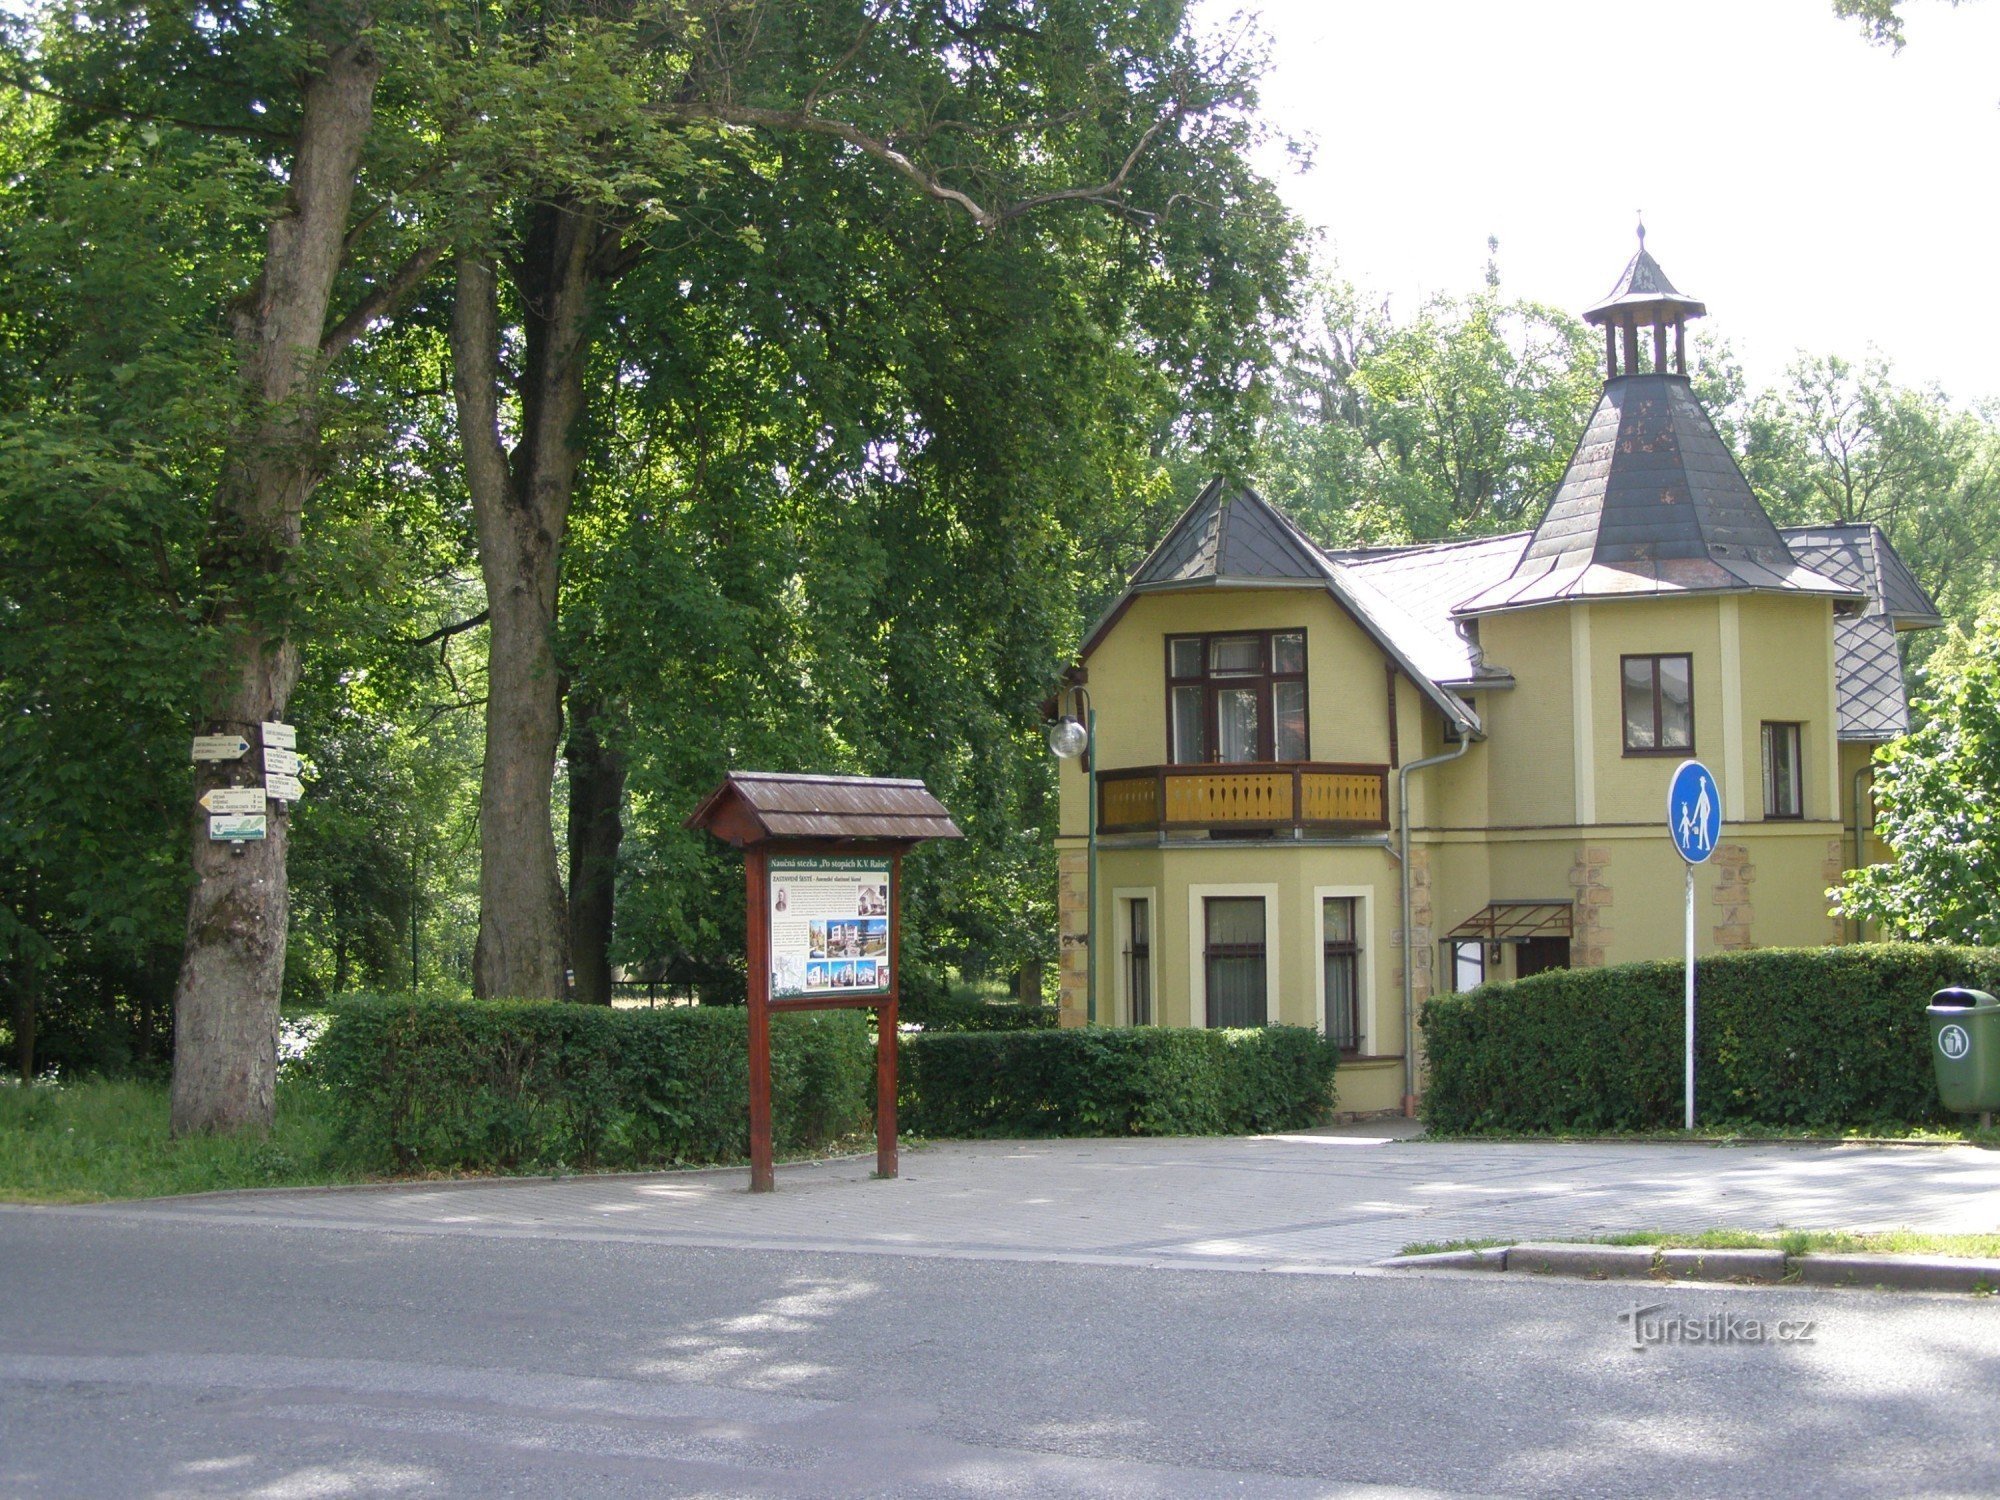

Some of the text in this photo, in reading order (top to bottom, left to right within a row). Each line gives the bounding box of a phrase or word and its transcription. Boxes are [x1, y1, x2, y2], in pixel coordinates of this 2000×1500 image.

[771, 859, 796, 868] Naučná
[797, 859, 818, 867] stezka
[831, 859, 856, 870] stopách
